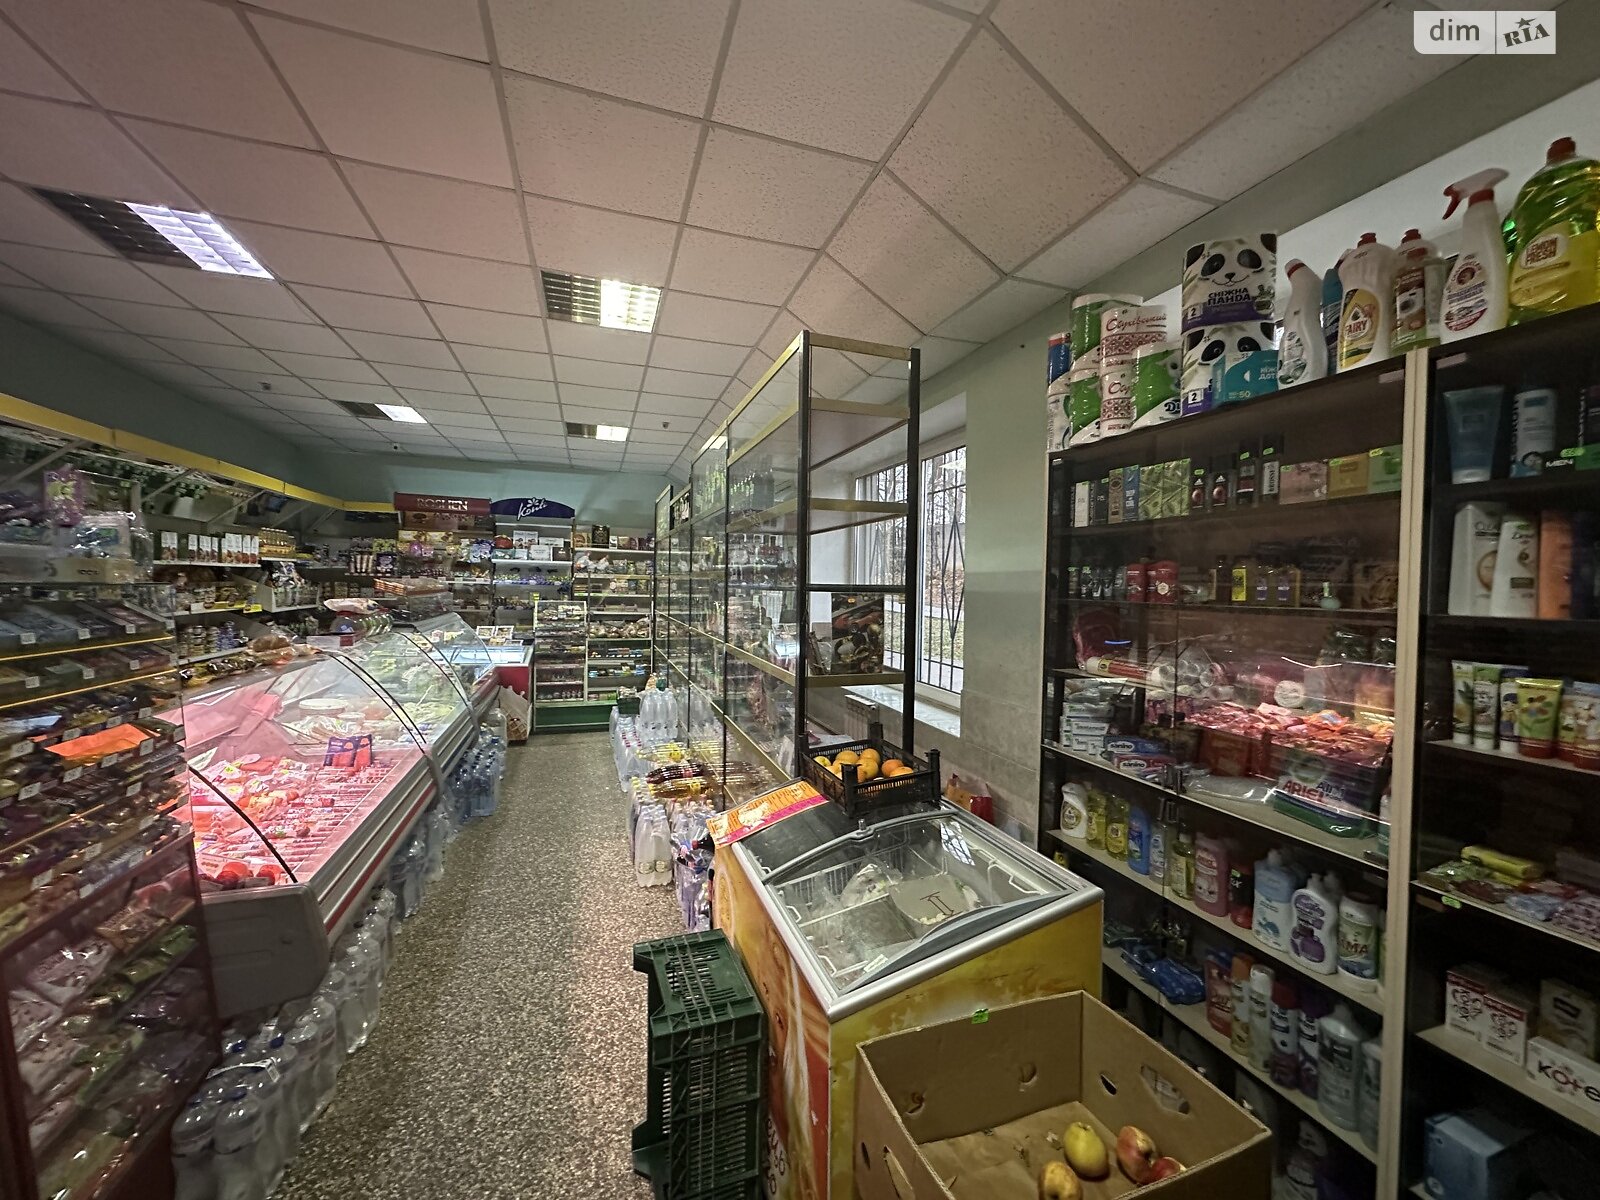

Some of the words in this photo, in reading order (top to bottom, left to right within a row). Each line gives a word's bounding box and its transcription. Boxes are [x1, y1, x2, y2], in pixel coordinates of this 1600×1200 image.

[1208, 287, 1249, 299] СНІЖНА
[1207, 293, 1251, 306] ПАНДА
[1190, 307, 1197, 317] 2
[1191, 392, 1198, 401] 2
[416, 497, 469, 511] ROSHEN
[1110, 742, 1134, 750] sanino
[1122, 761, 1146, 769] sanino
[1281, 780, 1324, 803] ARIEL
